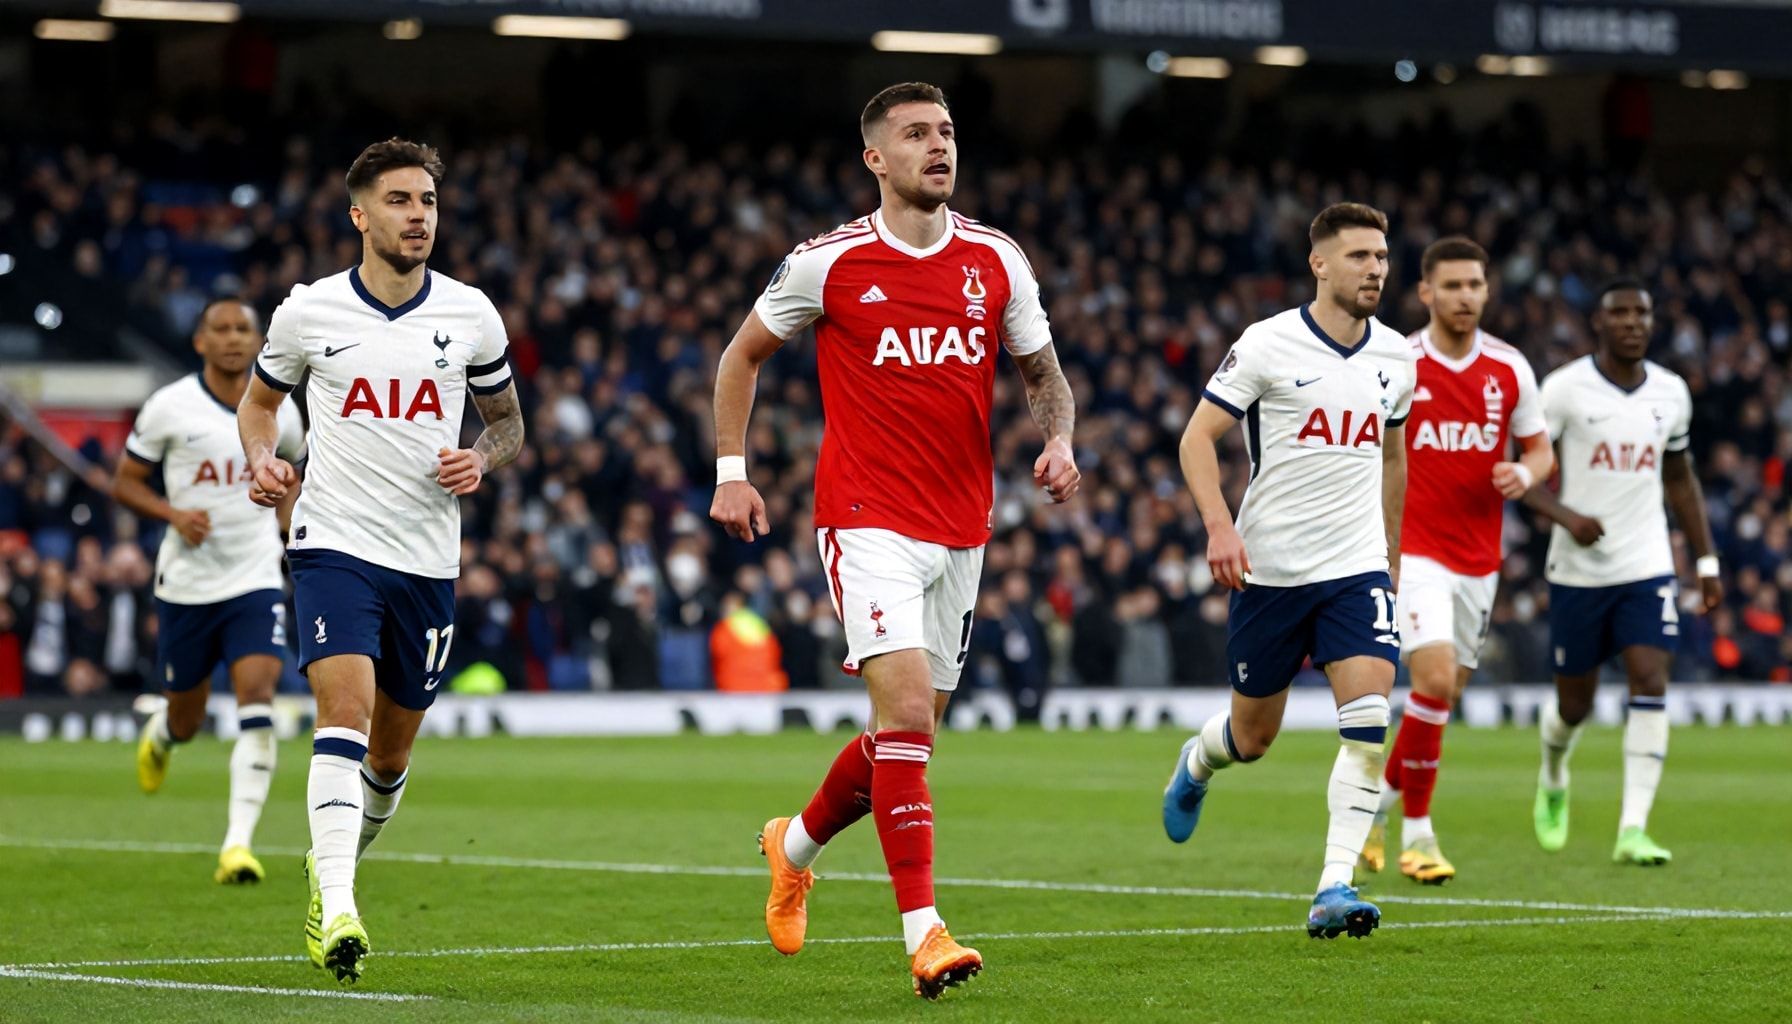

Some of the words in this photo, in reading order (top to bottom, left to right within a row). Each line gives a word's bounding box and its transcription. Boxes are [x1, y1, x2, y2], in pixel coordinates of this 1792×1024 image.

[341, 378, 444, 421] AIA
[1297, 408, 1381, 448] AIA
[425, 624, 454, 672] 17
